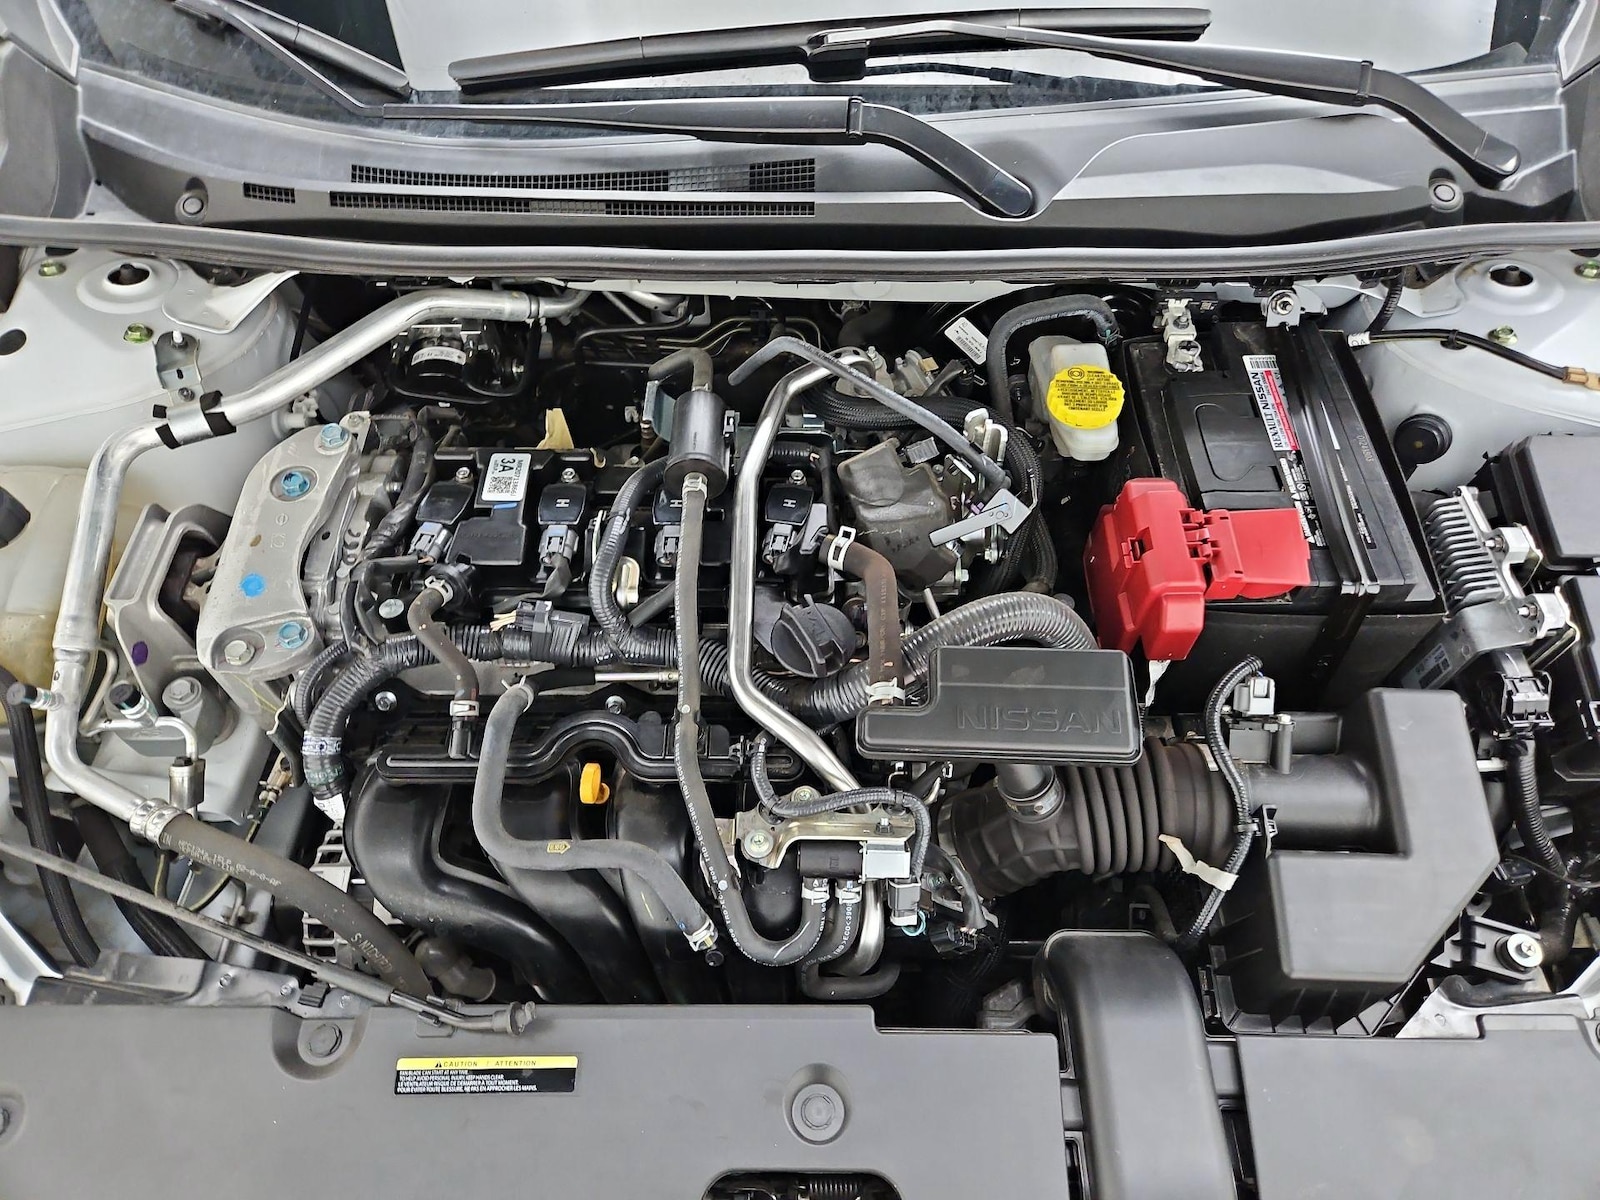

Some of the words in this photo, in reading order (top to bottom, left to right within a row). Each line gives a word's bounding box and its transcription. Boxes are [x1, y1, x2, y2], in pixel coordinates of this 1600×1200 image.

[1250, 372, 1270, 410] NISSAN
[1263, 413, 1284, 448] RENAULT
[499, 458, 516, 473] 3A
[955, 705, 1123, 734] NISSAN
